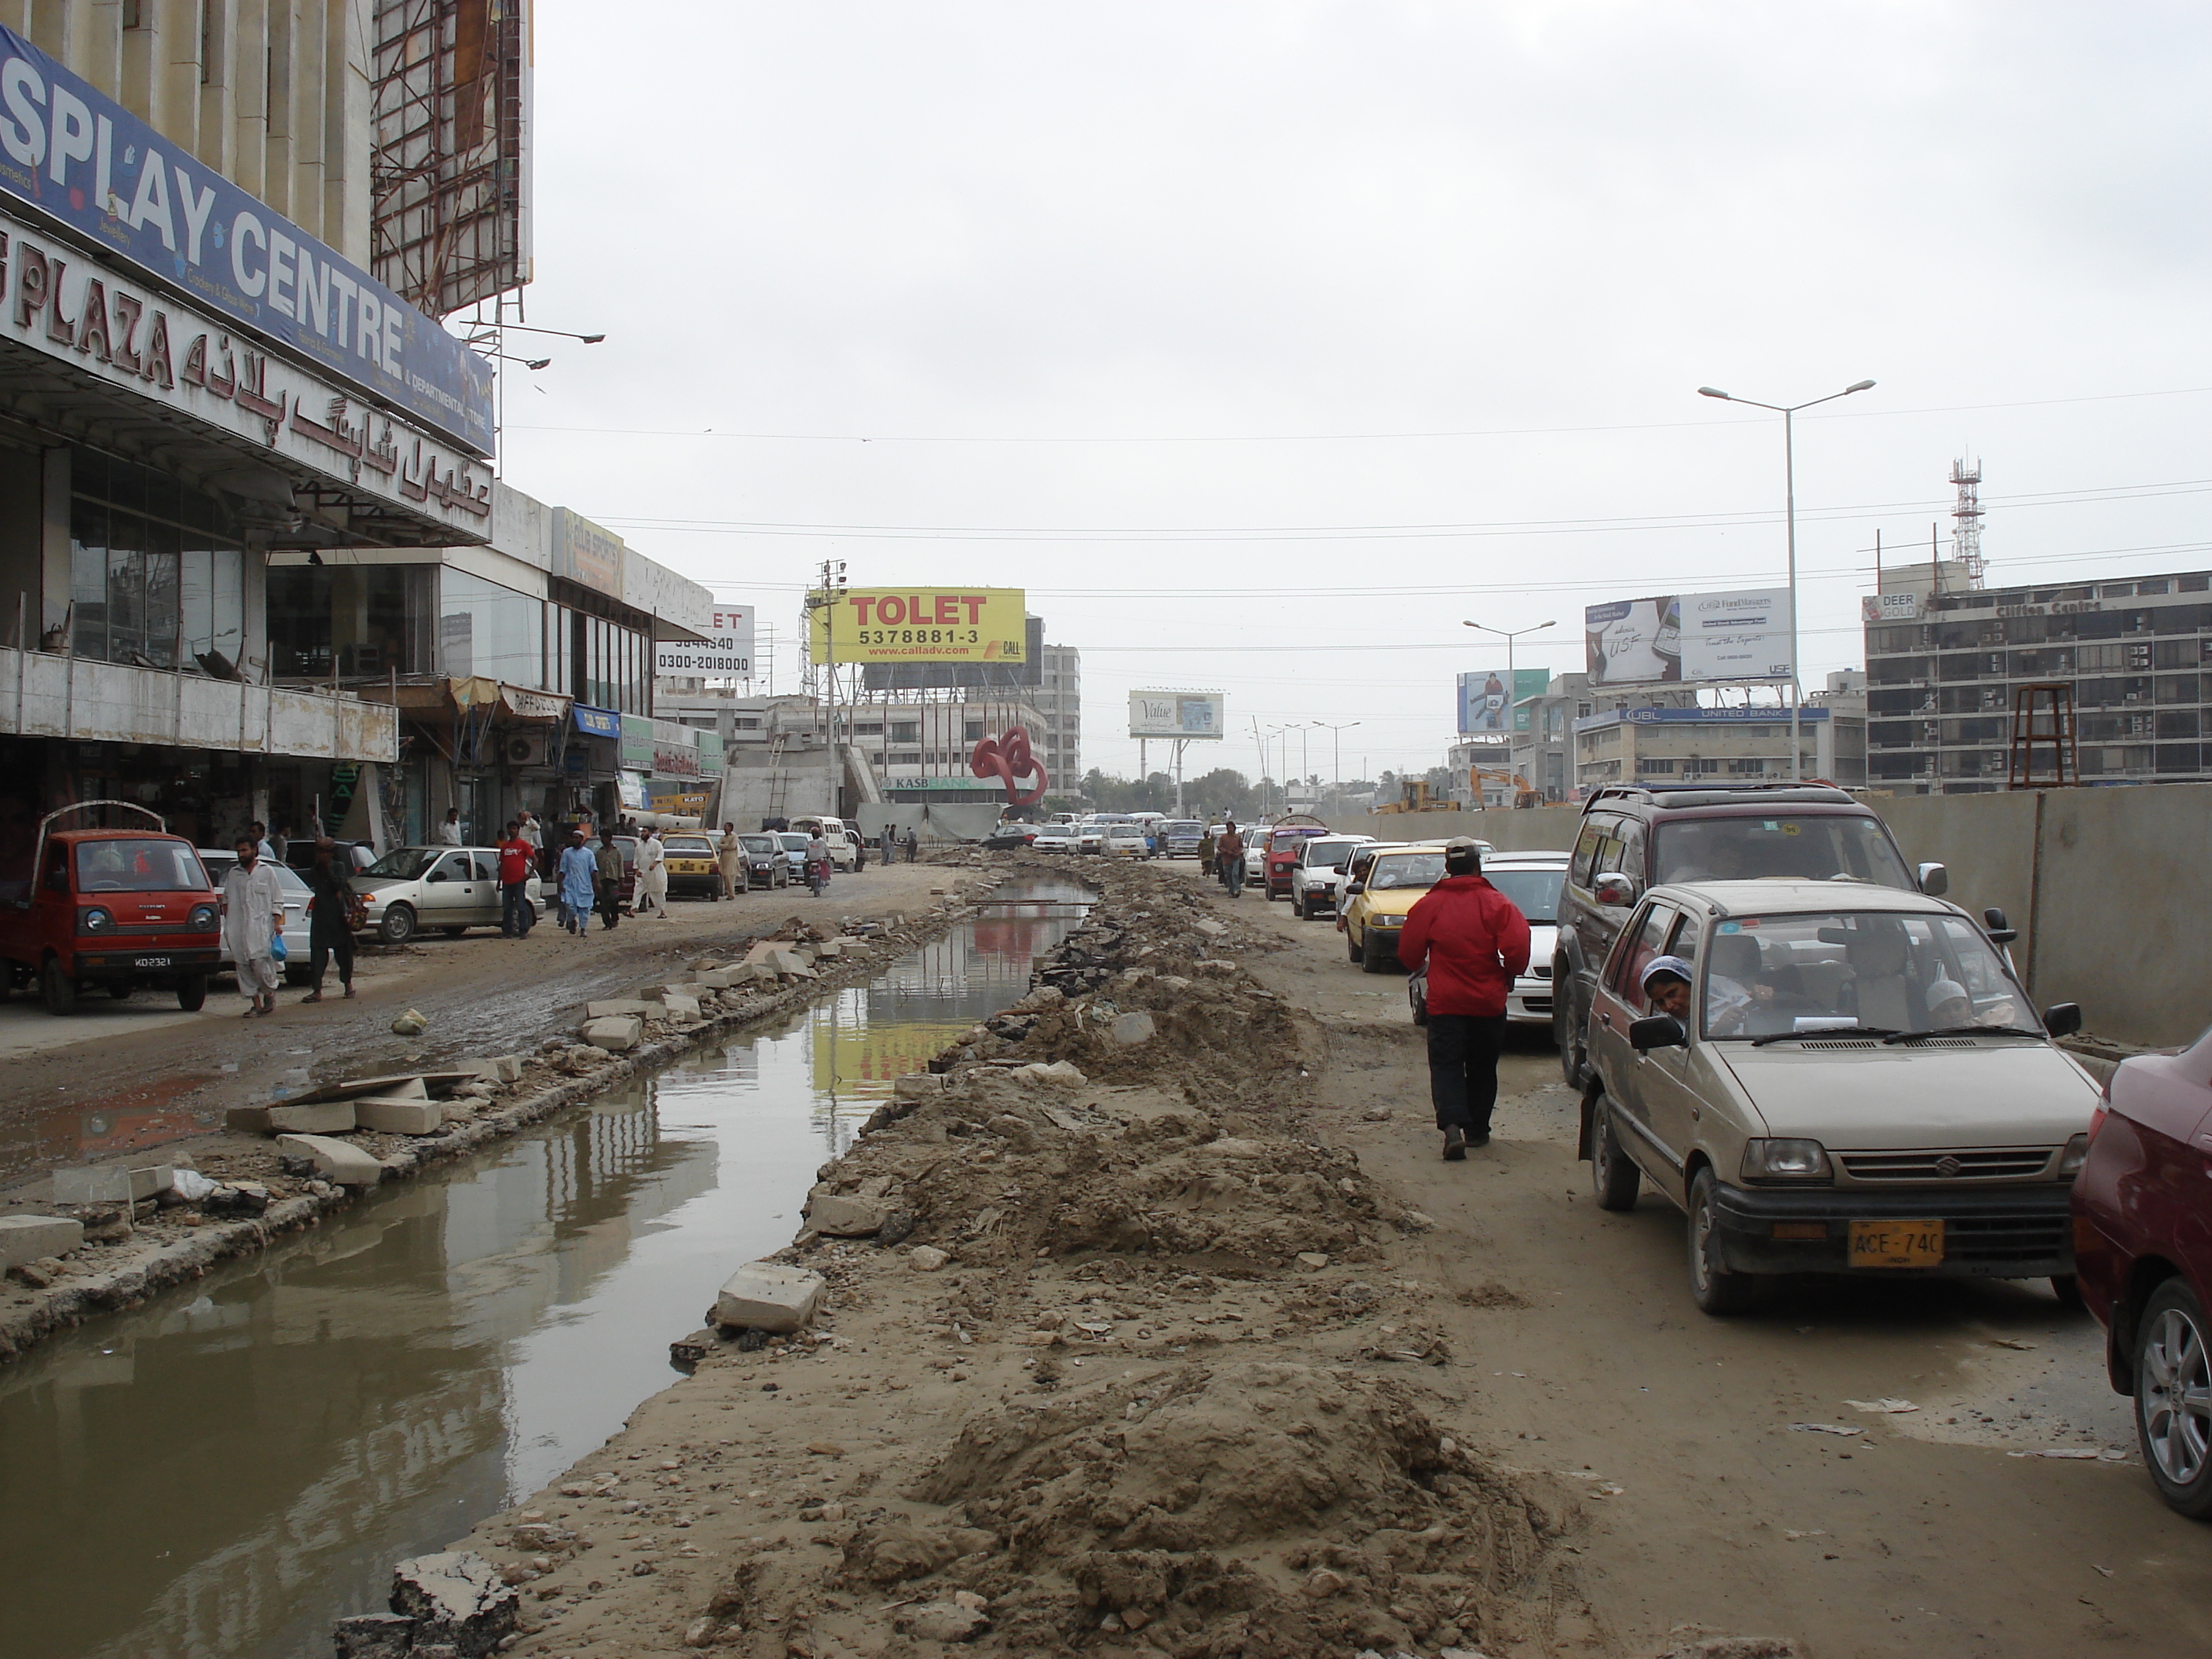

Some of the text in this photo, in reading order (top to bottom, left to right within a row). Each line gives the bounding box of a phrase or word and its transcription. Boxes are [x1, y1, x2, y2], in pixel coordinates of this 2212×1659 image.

[100, 216, 131, 249] Jewellery
[230, 211, 403, 382] CENTRE
[13, 240, 174, 390] PLAZA
[412, 373, 465, 417] DEPARTMENTAL
[1883, 595, 1914, 606] DEER
[849, 595, 987, 625] TOLET
[1884, 606, 1914, 617] GOLD
[1995, 603, 2045, 618] Clifton
[859, 629, 979, 644] 5378881-3
[868, 645, 969, 657] www.calladv.com
[1003, 640, 1020, 655] CALL
[659, 654, 748, 671] 0300-2018000
[1139, 699, 1172, 720] Value
[1630, 709, 1662, 720] UBL
[1701, 709, 1745, 718] UNITED
[1750, 709, 1784, 718] BANK
[896, 778, 928, 789] KASB
[928, 777, 972, 789] BANK
